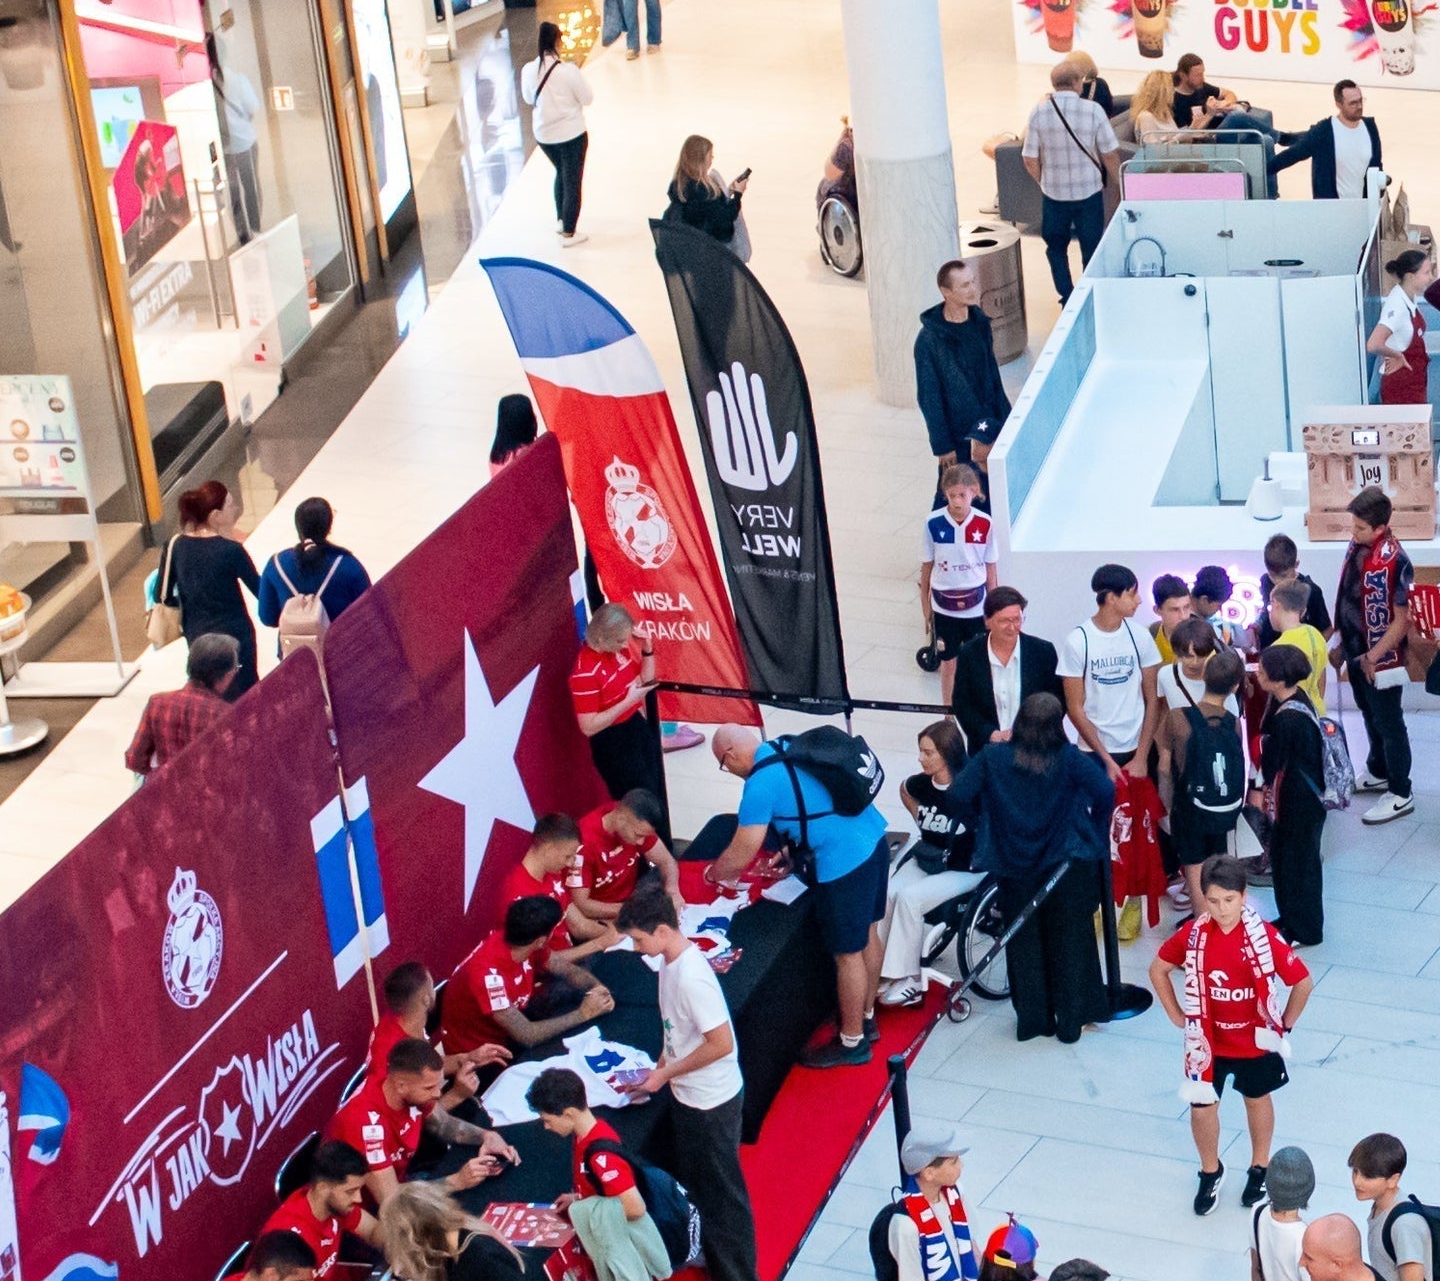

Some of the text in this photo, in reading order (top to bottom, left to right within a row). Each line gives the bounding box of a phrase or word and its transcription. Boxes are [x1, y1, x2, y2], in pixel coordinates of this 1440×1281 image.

[1213, 6, 1321, 56] GUYS
[1360, 464, 1382, 488] Joy
[633, 590, 695, 613] WISŁA
[635, 616, 711, 642] KRAKÓW
[1090, 655, 1135, 671] MALLORCA
[242, 1009, 322, 1115] WISŁA
[167, 1132, 212, 1217] JAK
[116, 1156, 162, 1258] W
